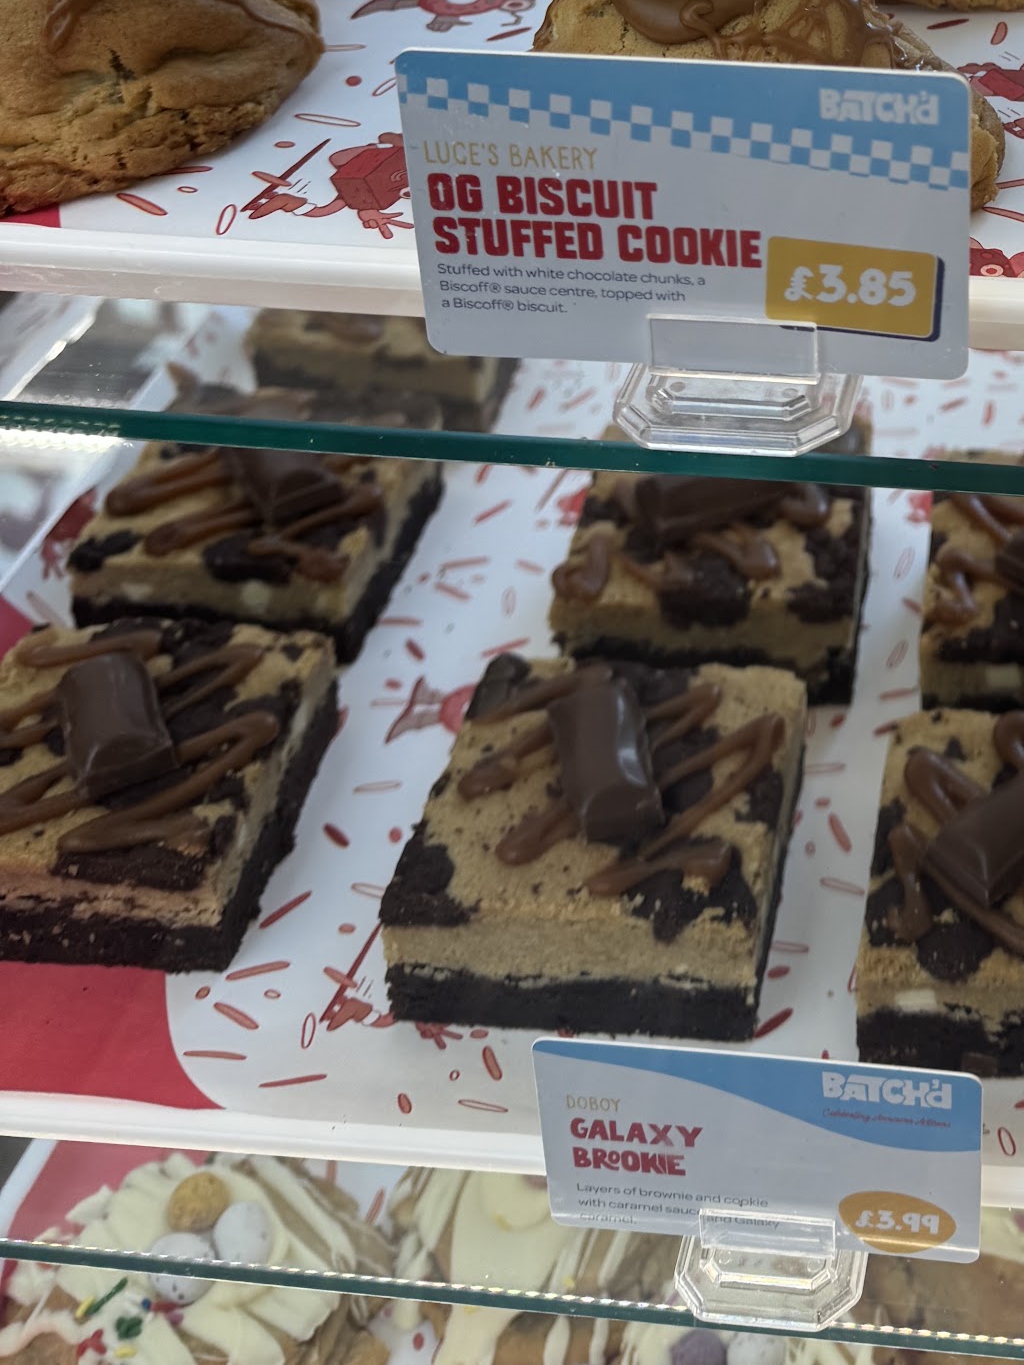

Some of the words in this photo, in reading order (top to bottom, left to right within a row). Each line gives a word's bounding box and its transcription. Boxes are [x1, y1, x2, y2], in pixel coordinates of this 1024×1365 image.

[508, 143, 598, 170] BAKERY
[427, 173, 483, 212] OG
[496, 175, 658, 220] BISCUIT
[432, 217, 604, 260] STUFFED
[617, 224, 763, 269] COOKIE
[437, 263, 490, 278] Stuffed
[493, 265, 523, 278] with
[525, 266, 565, 280] white
[567, 269, 638, 283] chocolate
[640, 272, 695, 287] chunks,
[697, 276, 706, 286] a
[784, 263, 917, 307] £3.85
[439, 280, 502, 295] Biscoff®
[504, 284, 547, 296] sauce
[549, 285, 599, 299] centre,
[600, 287, 653, 303] topped
[655, 290, 686, 302] with
[441, 299, 451, 309] a
[453, 297, 514, 312] Biscoff®
[517, 300, 568, 314] biscuit.
[566, 1094, 621, 1113] DOBOY
[822, 1071, 953, 1110] BATCH'd
[570, 1117, 703, 1147] GALAXY
[572, 1146, 686, 1176] BROOKIE
[576, 1182, 621, 1196] Layers
[623, 1186, 638, 1196] of
[639, 1188, 693, 1201] brownie
[695, 1193, 721, 1204] and
[723, 1196, 769, 1208] cookie
[578, 1198, 606, 1208] with
[608, 1200, 663, 1212] caramel
[855, 1210, 940, 1235] £3.99
